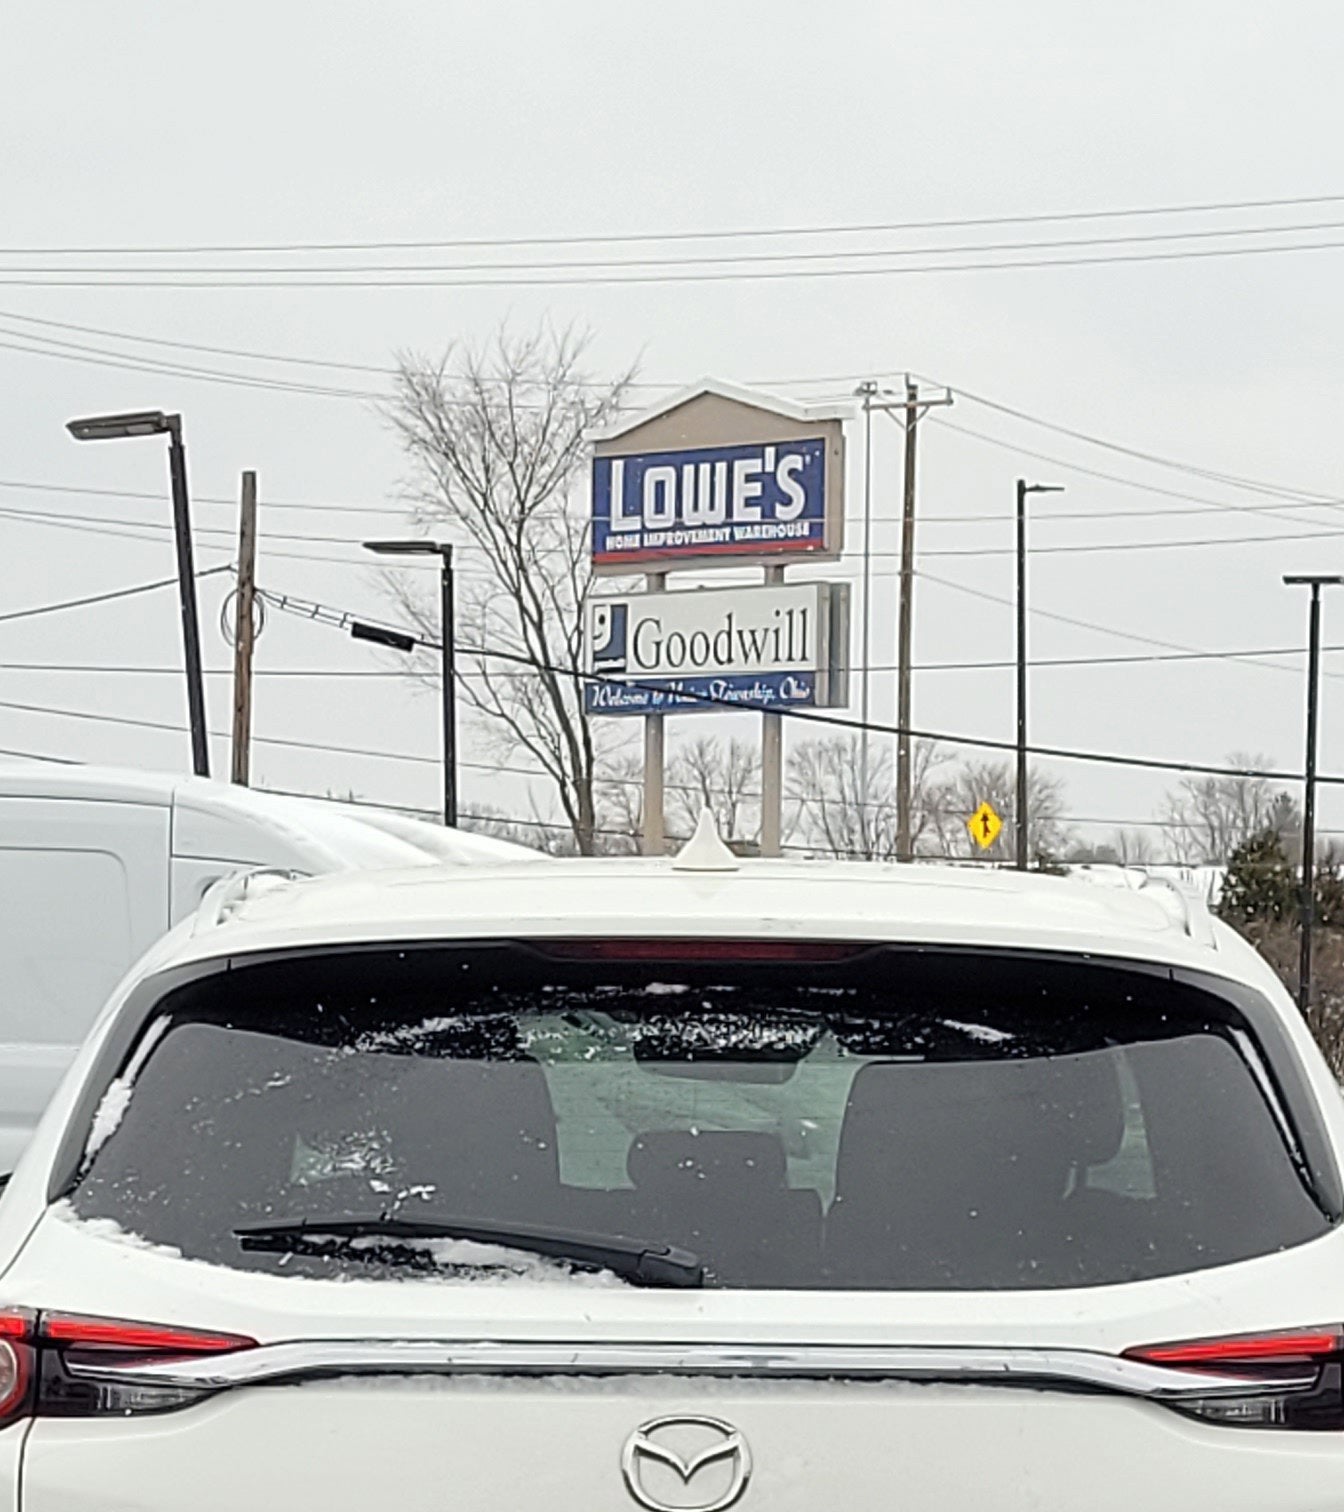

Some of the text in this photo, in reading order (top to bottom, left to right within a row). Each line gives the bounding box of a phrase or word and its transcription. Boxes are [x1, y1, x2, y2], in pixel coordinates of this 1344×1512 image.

[609, 446, 807, 532] LOWE'S
[605, 522, 810, 550] HOME IMPROVEMENT WAREHOUSE
[633, 607, 810, 669] Goodwill
[779, 676, 811, 699] Ohio
